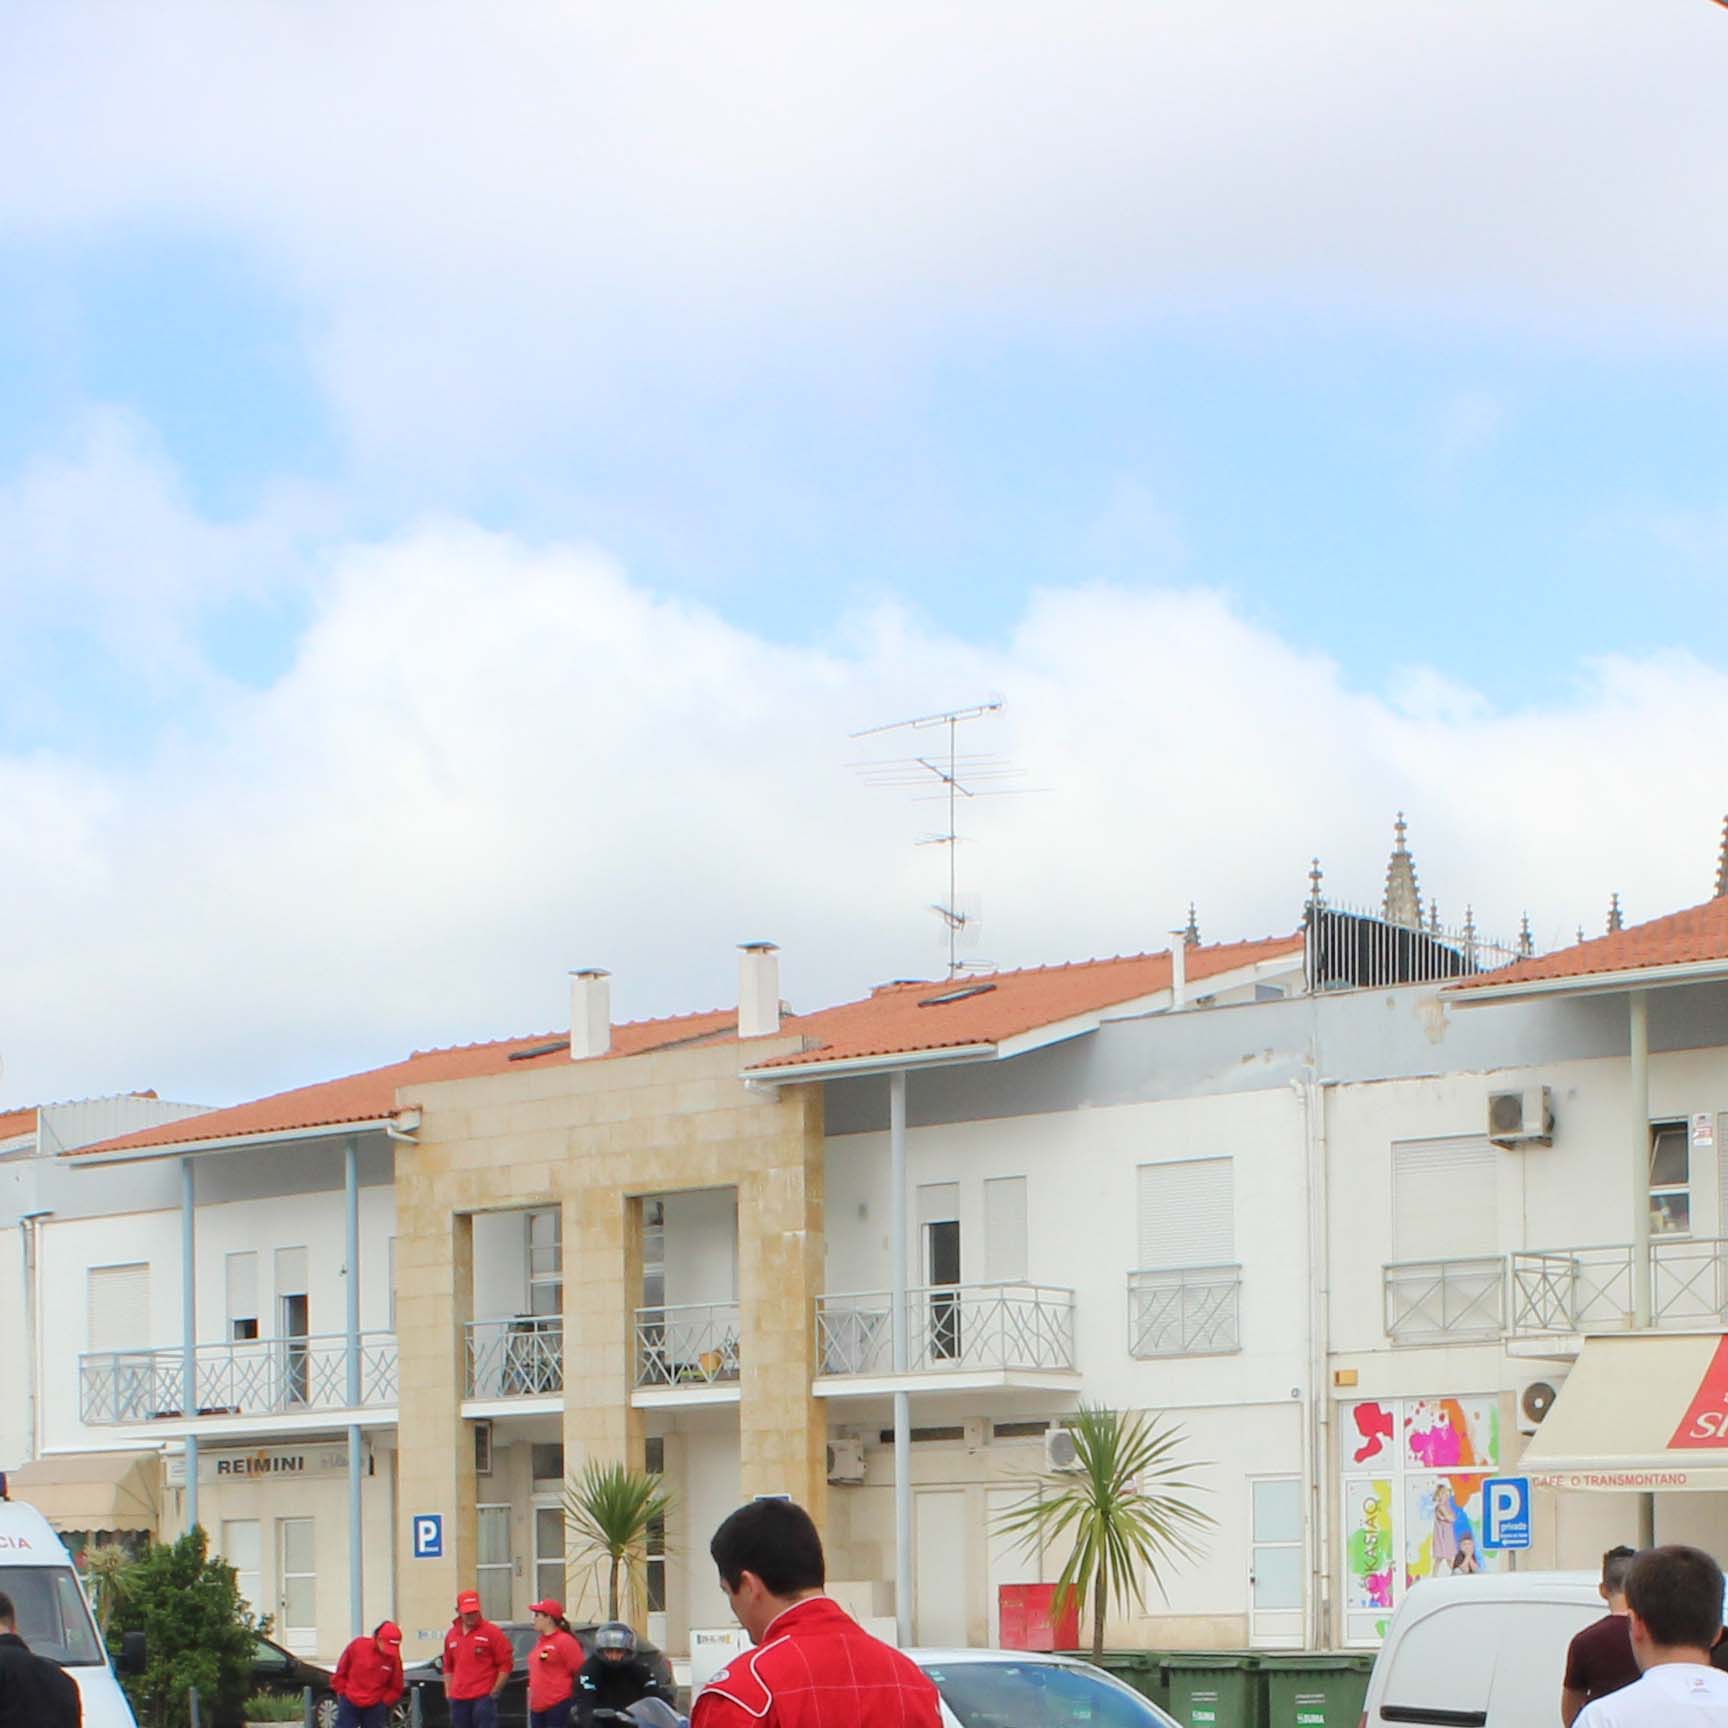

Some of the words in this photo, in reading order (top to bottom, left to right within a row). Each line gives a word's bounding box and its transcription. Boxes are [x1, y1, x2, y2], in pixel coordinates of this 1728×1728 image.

[217, 1456, 304, 1475] REIMINI
[1570, 1476, 1581, 1487] O
[1583, 1474, 1687, 1487] TRANSMONTANO
[1490, 1484, 1521, 1543] P
[418, 1520, 438, 1553] P
